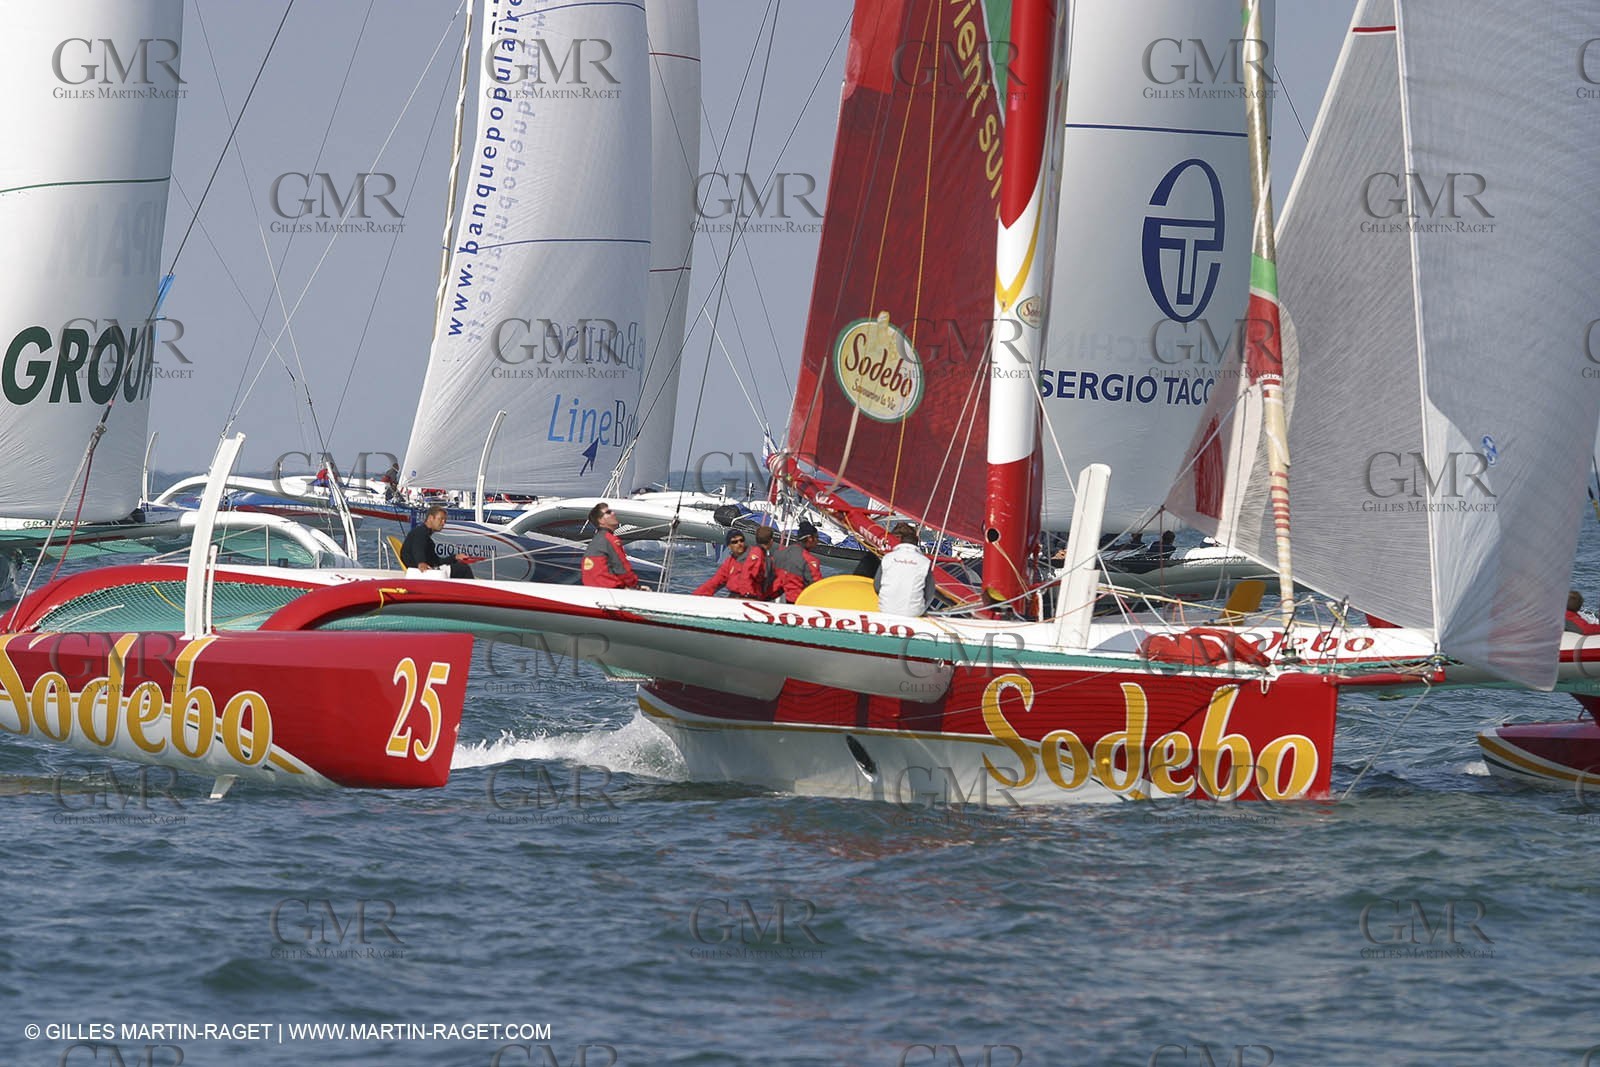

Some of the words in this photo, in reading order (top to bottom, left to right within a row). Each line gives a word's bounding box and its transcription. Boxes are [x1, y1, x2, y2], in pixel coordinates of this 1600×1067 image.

[950, 0, 991, 118] ient
[845, 333, 912, 397] Sodebo
[1039, 370, 1158, 404] SERGIO
[548, 394, 638, 447] LineBo
[742, 602, 915, 638] Sodebo
[386, 657, 450, 763] 25
[981, 673, 1319, 803] Sodebo
